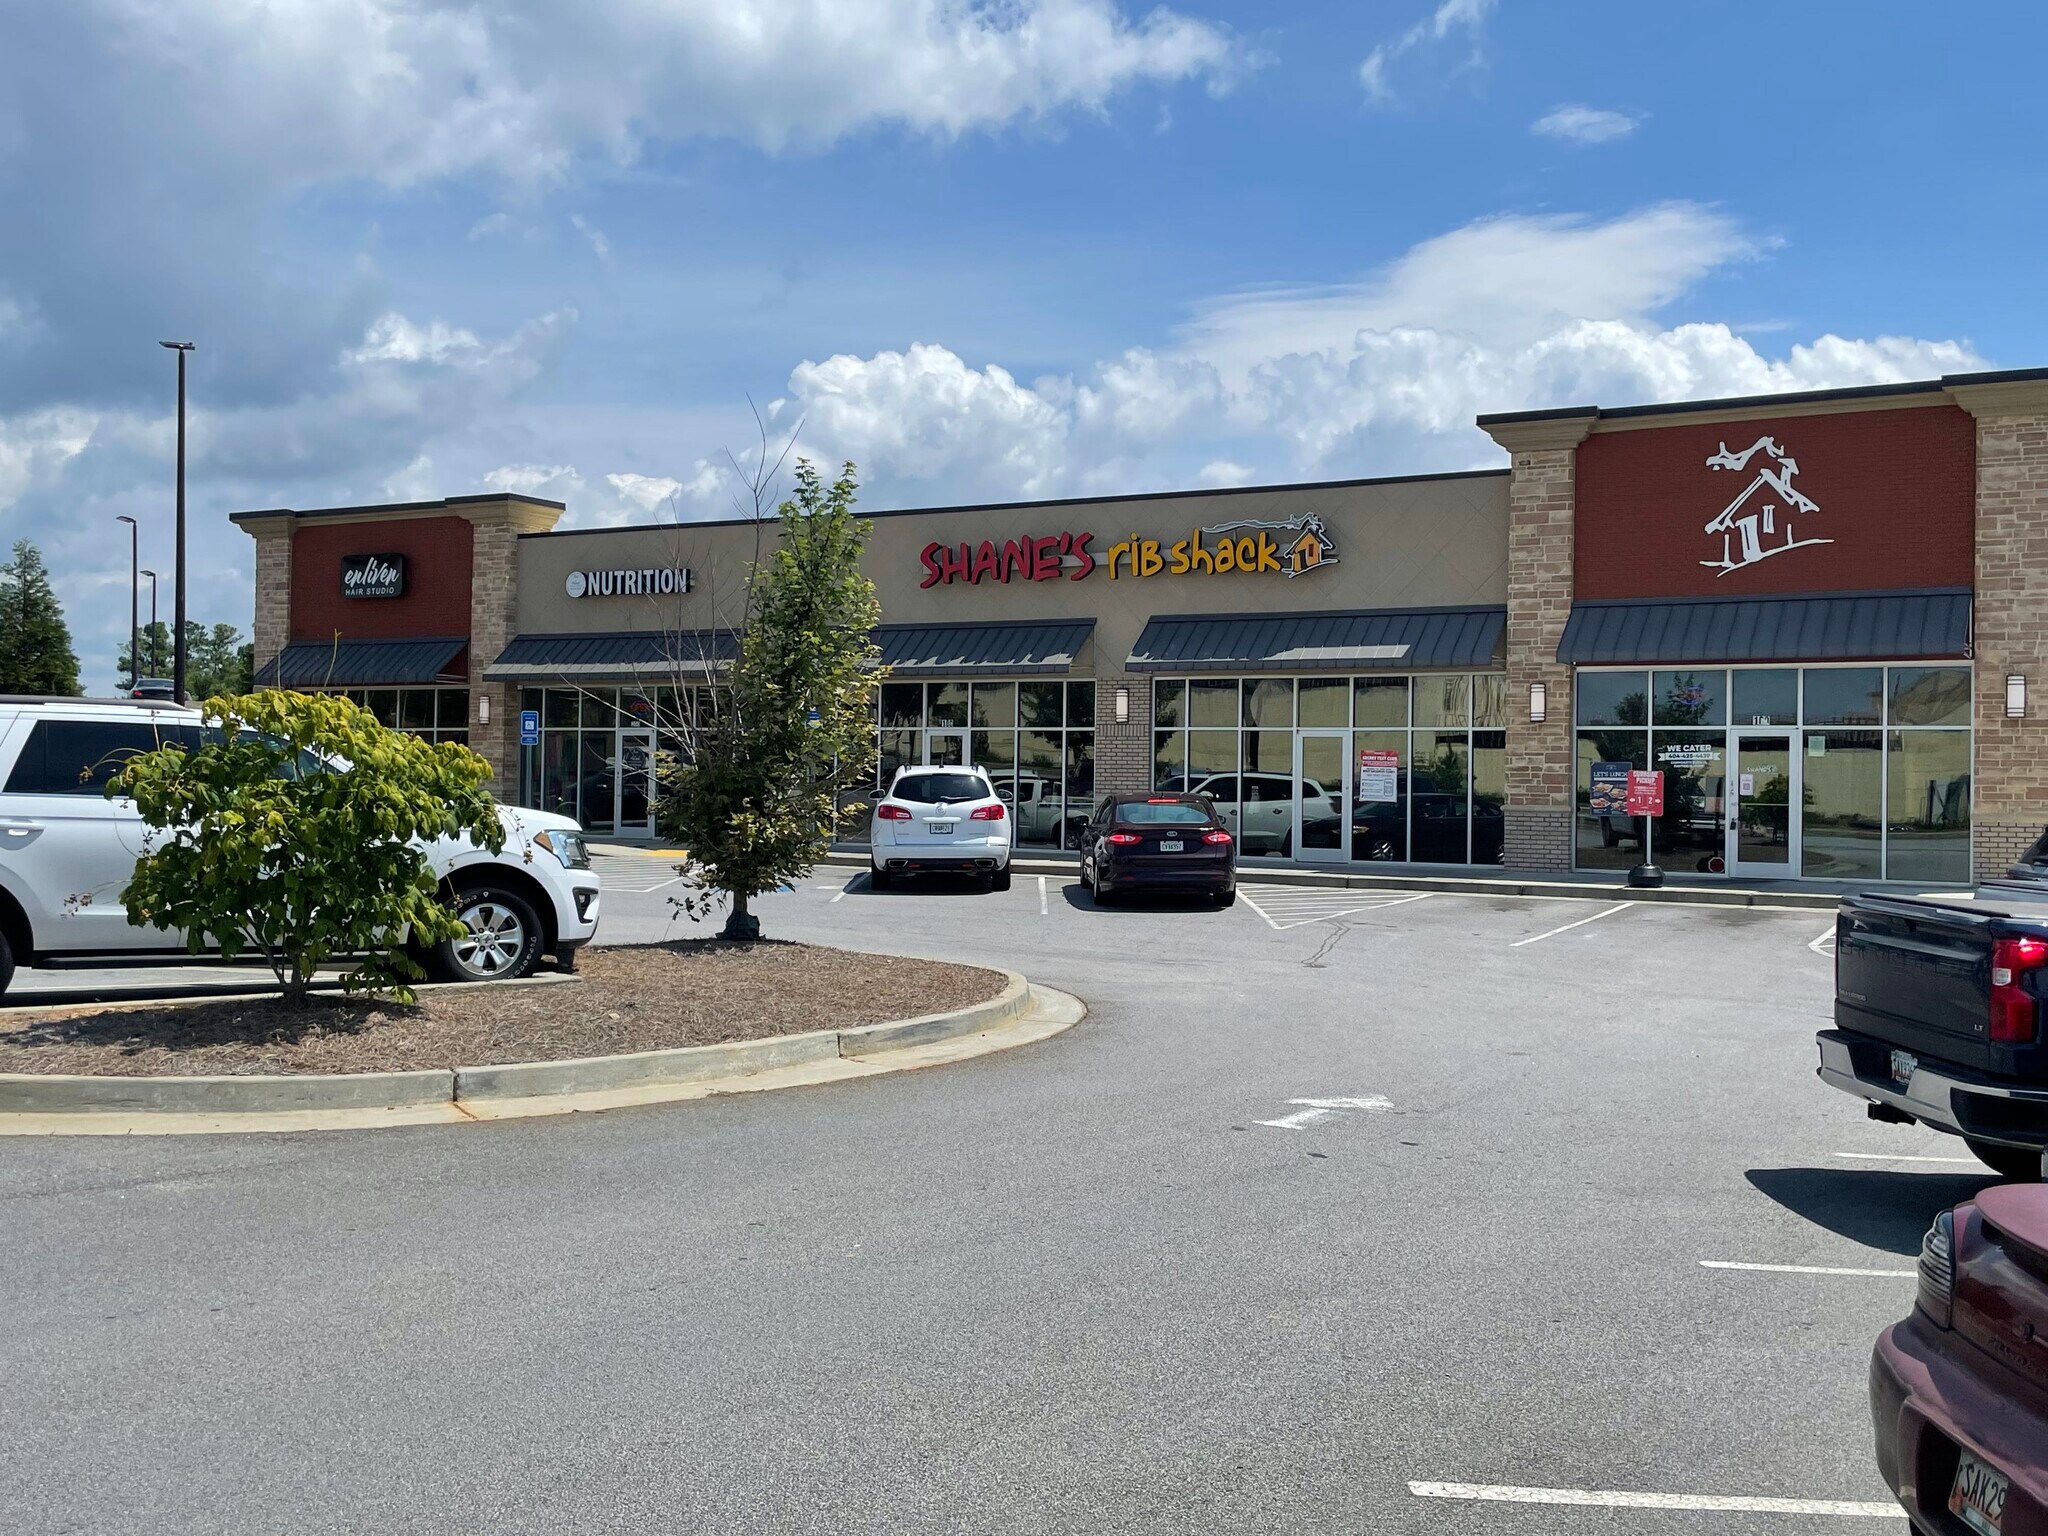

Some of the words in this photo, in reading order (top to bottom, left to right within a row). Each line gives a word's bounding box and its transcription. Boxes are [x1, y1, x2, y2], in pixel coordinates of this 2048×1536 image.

[920, 531, 1096, 589] SHANE'S
[1170, 528, 1282, 576] shack
[344, 556, 400, 588] enliven
[588, 568, 687, 596] NUTRITION
[345, 588, 364, 596] HAIR
[366, 587, 395, 596] STUDIO
[1667, 744, 1682, 752] WE
[1683, 744, 1712, 752] CATER
[1648, 796, 1653, 805] 2
[1974, 1023, 1983, 1032] LT
